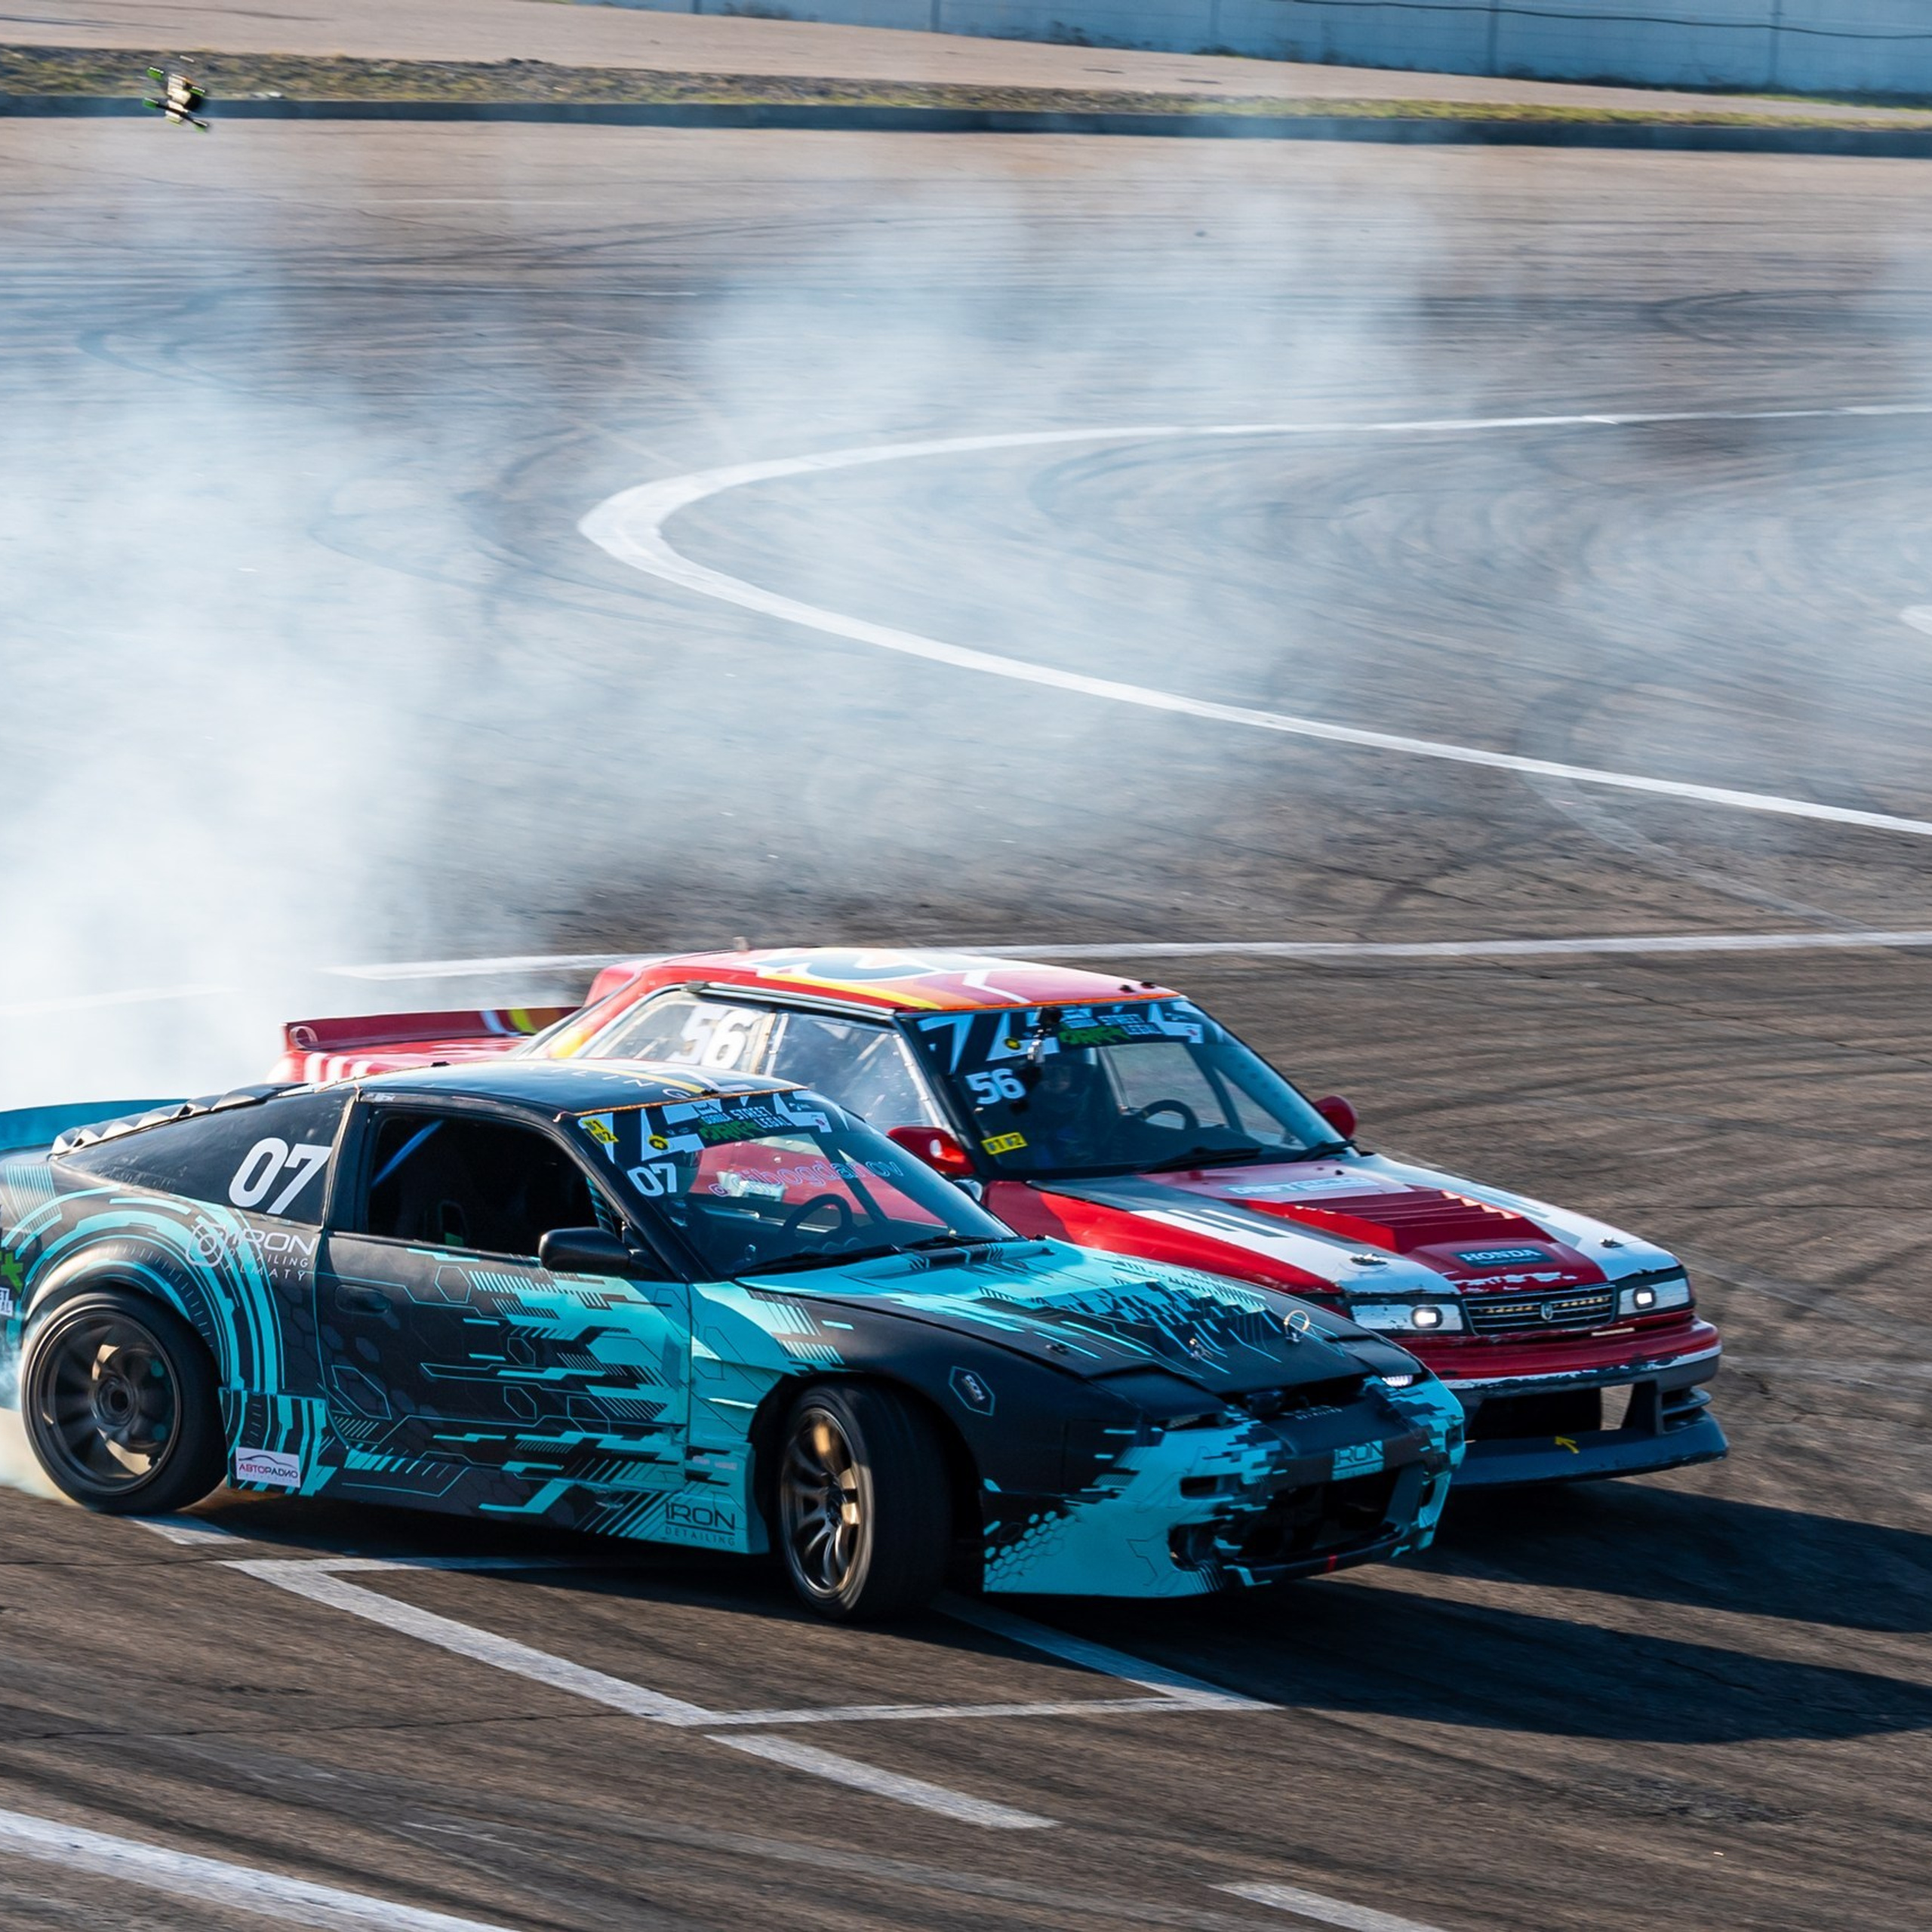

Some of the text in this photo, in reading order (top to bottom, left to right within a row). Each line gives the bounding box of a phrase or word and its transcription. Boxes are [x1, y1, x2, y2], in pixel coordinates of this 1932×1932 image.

[664, 1004, 764, 1069] 56
[965, 1068, 1026, 1104] 56
[730, 1106, 774, 1120] STREET
[755, 1115, 793, 1128] LEGAL
[229, 1137, 333, 1215] 07
[627, 1163, 677, 1197] 07
[232, 1228, 316, 1255] IRON
[1459, 1249, 1541, 1261] HONDA
[226, 1264, 306, 1281] ALMATY
[665, 1502, 735, 1531] IRON
[665, 1526, 735, 1547] DETAILING
